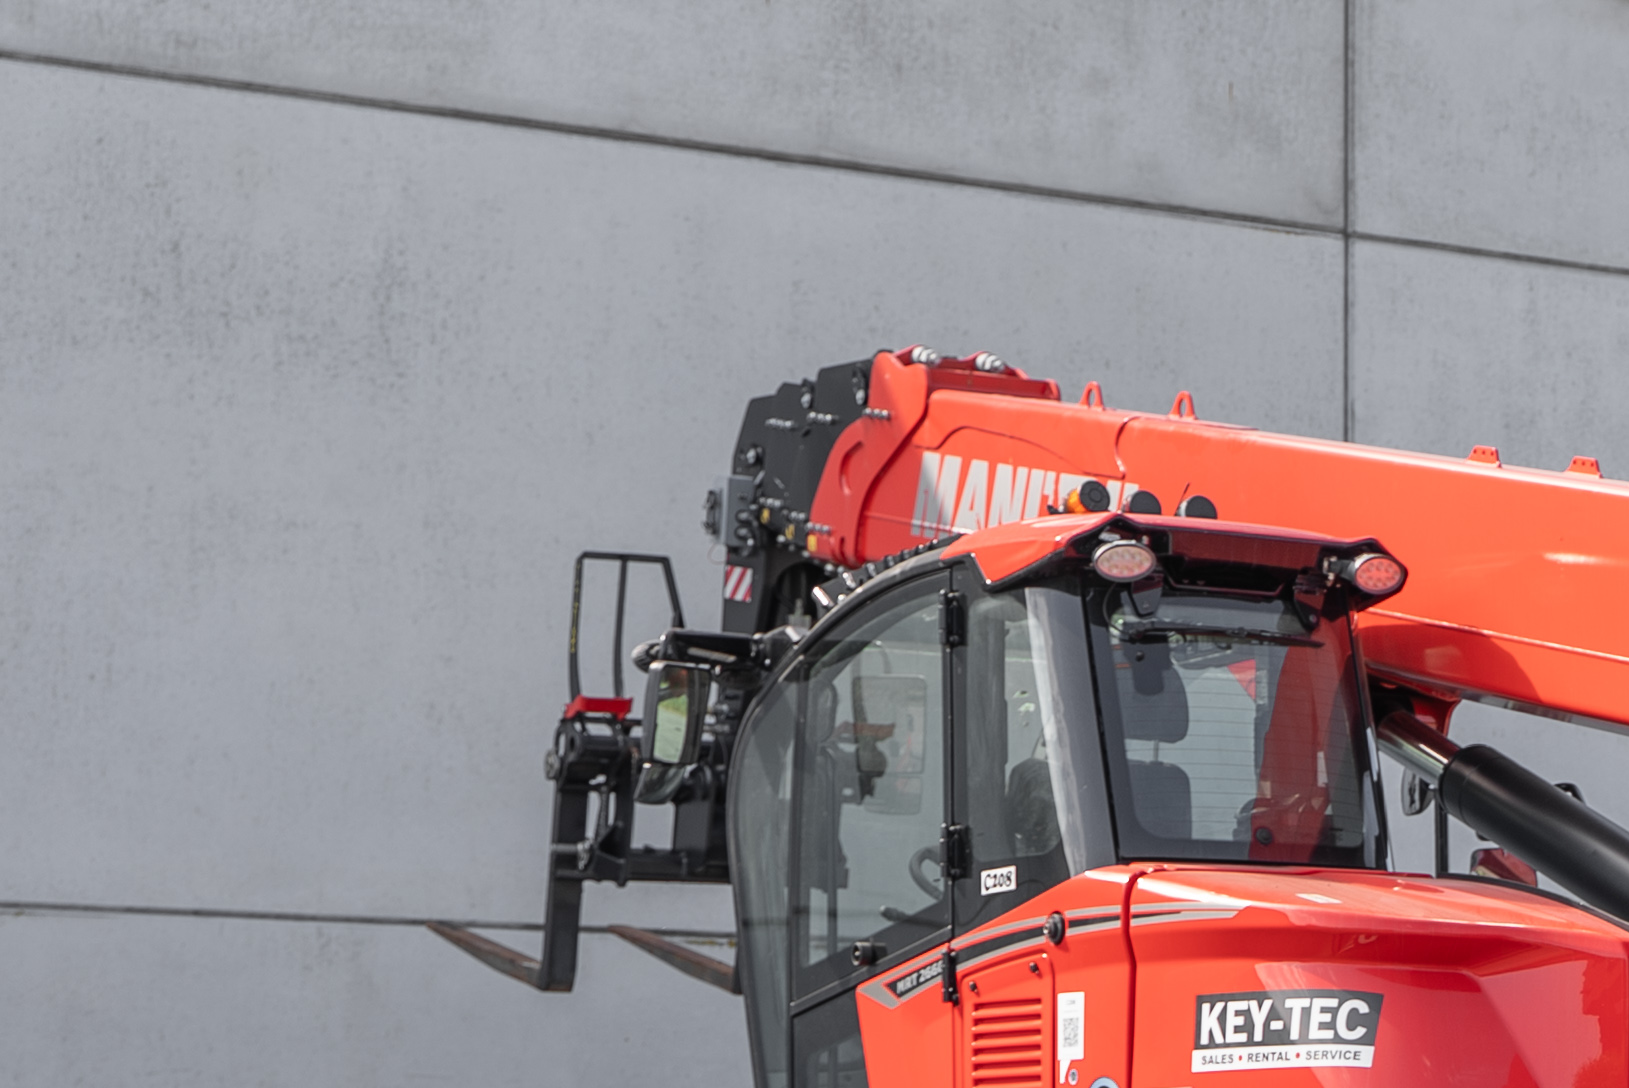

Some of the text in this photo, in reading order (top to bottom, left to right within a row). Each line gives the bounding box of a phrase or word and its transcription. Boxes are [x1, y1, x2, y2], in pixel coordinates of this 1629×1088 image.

[1200, 997, 1370, 1046] KEY-TEC
[1201, 1050, 1362, 1065] SALES RENTAL SERVICE
